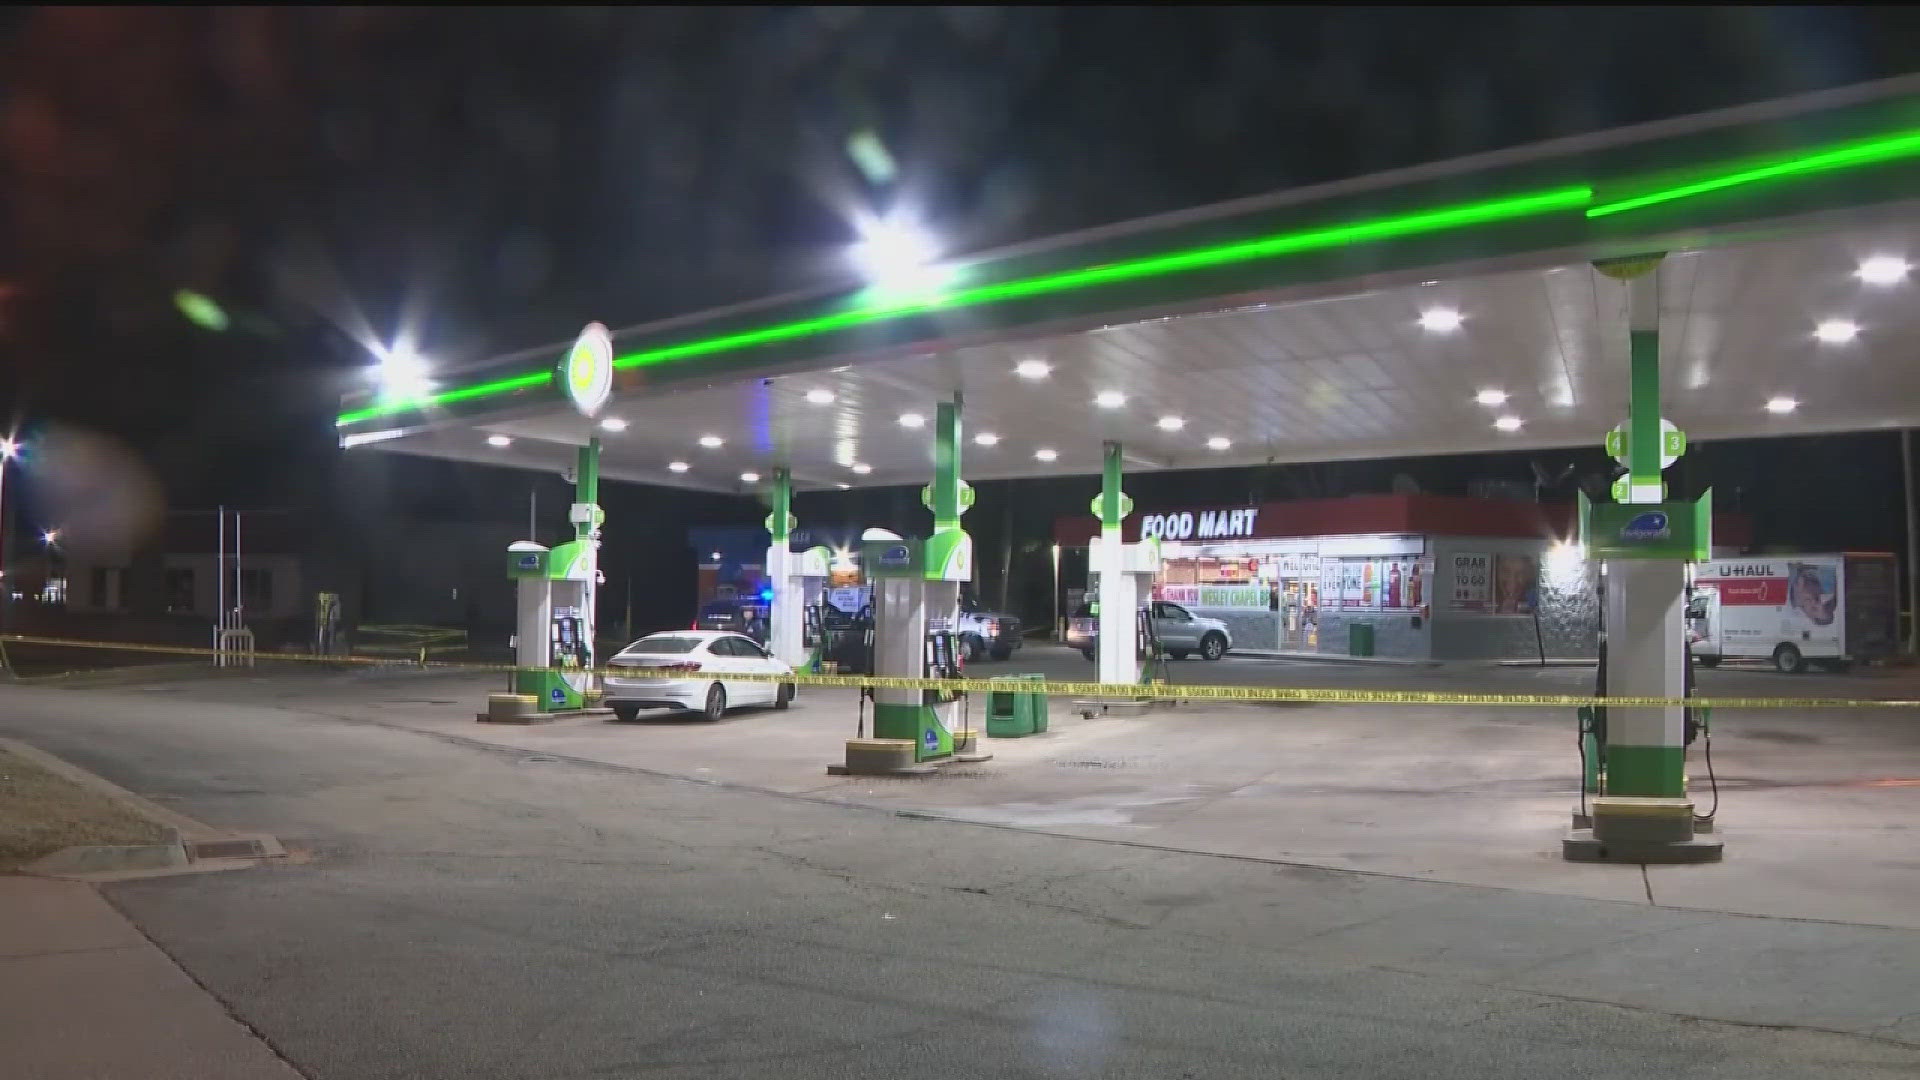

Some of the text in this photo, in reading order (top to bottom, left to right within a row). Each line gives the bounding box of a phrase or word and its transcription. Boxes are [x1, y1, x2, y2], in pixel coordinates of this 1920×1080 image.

[1141, 509, 1258, 540] FOOD MART
[1455, 557, 1486, 568] GRAB
[1456, 575, 1486, 585] TO GO
